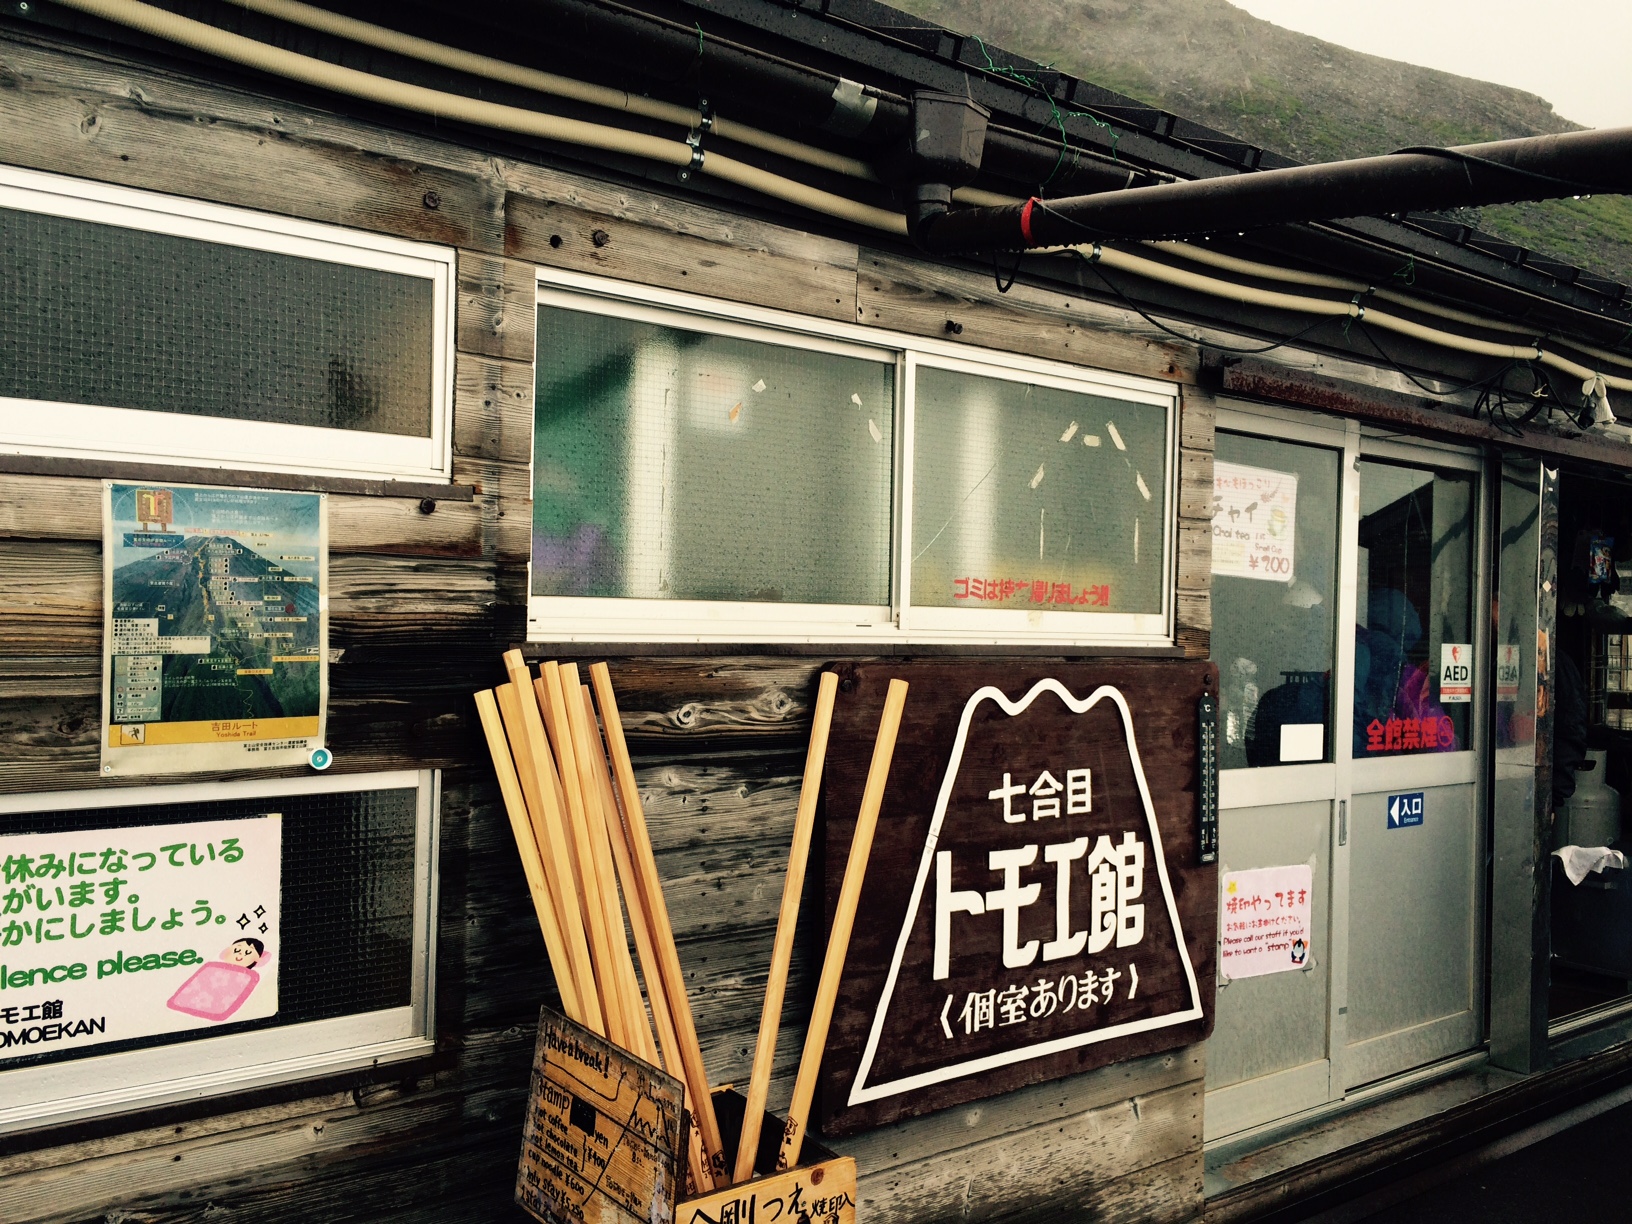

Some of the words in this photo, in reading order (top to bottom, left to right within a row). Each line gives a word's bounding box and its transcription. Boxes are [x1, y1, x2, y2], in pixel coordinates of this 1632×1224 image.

[1443, 665, 1468, 681] AED
[211, 721, 258, 732] 吉田ルート
[1366, 717, 1438, 751] 全館禁煙
[989, 768, 1092, 823] 七合目
[1401, 798, 1422, 816] 入口
[0, 838, 244, 884] 休みになっている
[0, 877, 140, 914] がいます。
[933, 831, 1145, 981] トモエ館
[0, 900, 226, 947] かにしましょう。
[1266, 930, 1281, 939] staff
[97, 948, 204, 979] please.
[548, 1114, 568, 1136] coffee
[594, 1130, 609, 1150] yen
[545, 1138, 565, 1161] lemon
[546, 1127, 578, 1157] chocolate
[528, 1149, 541, 1165] cup
[541, 1158, 563, 1180] noodle
